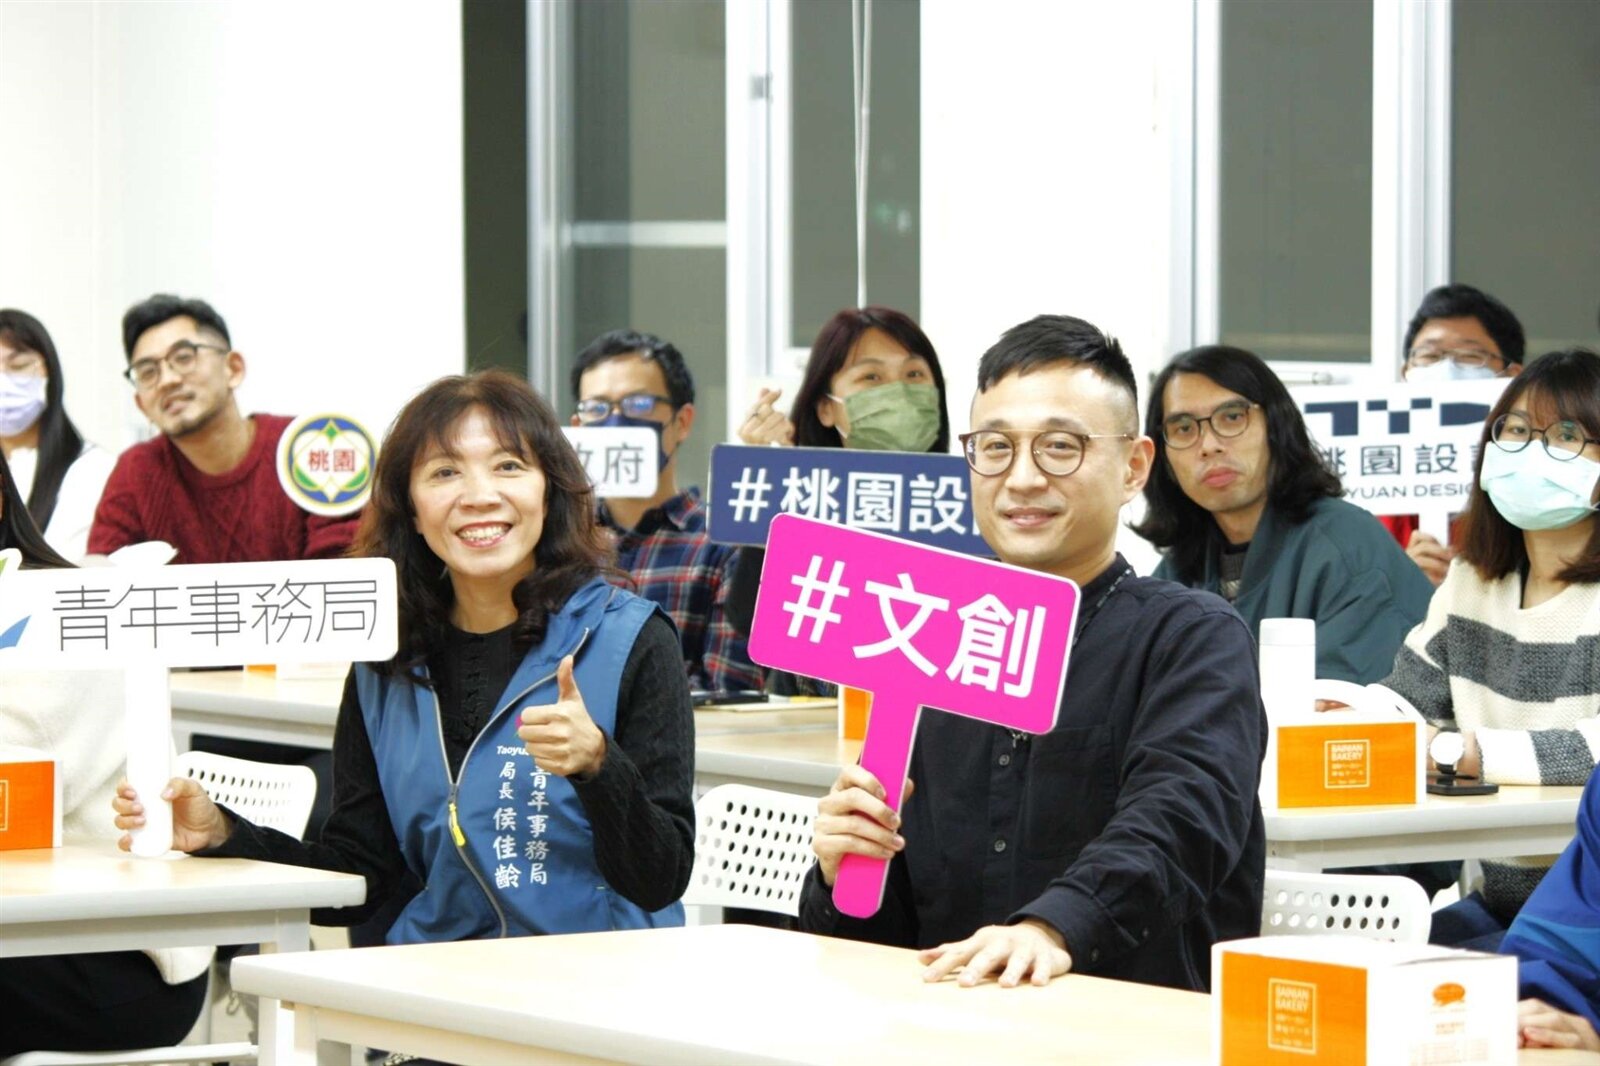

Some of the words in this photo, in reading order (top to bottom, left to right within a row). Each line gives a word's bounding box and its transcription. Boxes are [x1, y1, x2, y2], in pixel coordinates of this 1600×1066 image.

[308, 448, 356, 473] 桃園
[728, 467, 981, 536] #桃園設
[1345, 485, 1407, 499] YUAN
[53, 579, 376, 651] 青年事務局
[782, 555, 1047, 698] #文創
[499, 761, 516, 800] 局長
